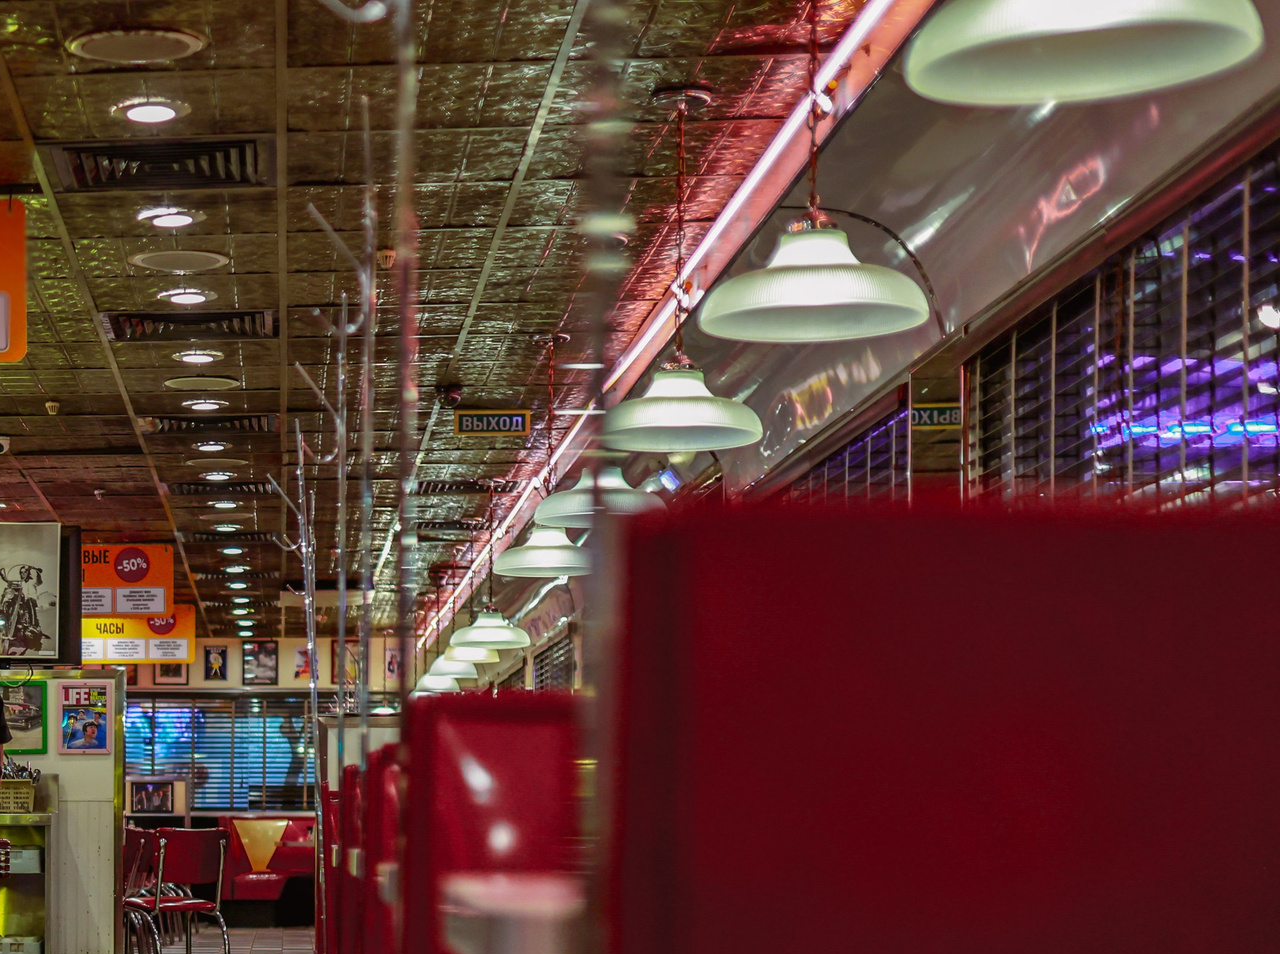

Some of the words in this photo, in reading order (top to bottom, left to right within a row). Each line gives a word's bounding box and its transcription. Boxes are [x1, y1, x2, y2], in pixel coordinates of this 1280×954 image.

[462, 416, 523, 431] ВЫХОД
[117, 557, 147, 572] -50%
[96, 623, 124, 634] ЧАСЫ
[63, 688, 90, 705] LIFE
